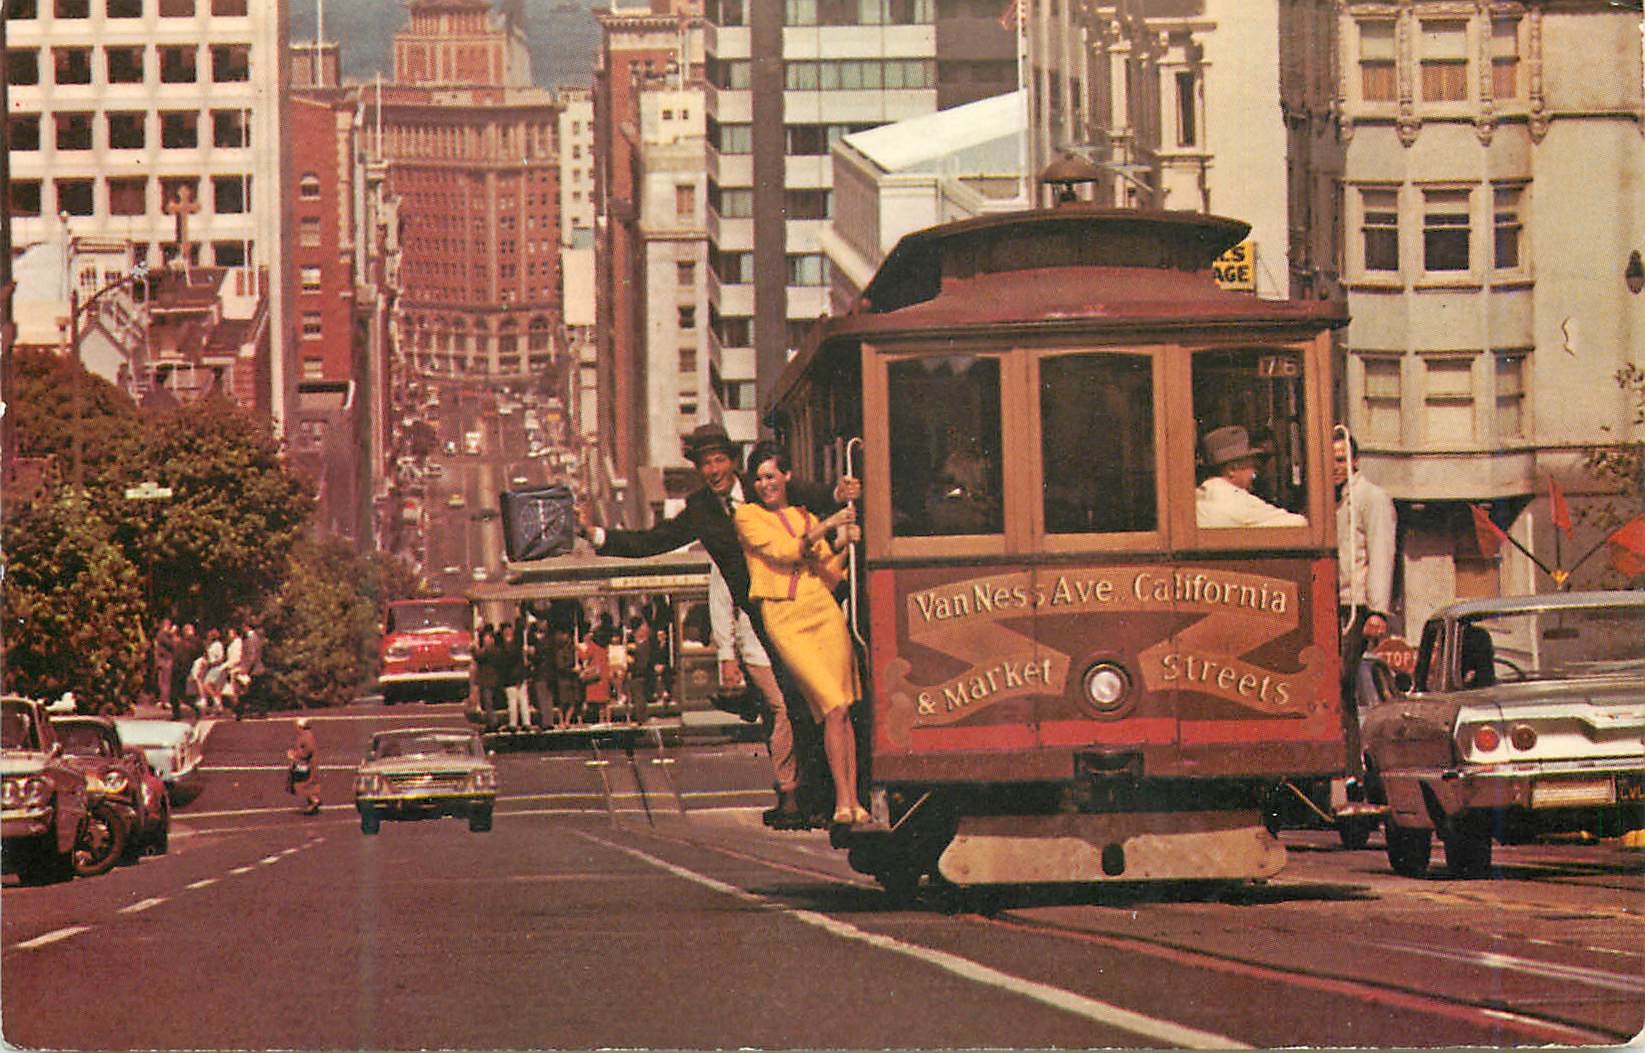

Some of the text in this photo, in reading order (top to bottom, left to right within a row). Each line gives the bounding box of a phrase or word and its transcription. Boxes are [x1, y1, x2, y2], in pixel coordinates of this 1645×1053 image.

[915, 592, 969, 622] Van
[973, 582, 1046, 613] Ness
[1133, 569, 1287, 614] California
[917, 652, 1290, 715] & Market Streets
[1376, 651, 1412, 667] TOP
